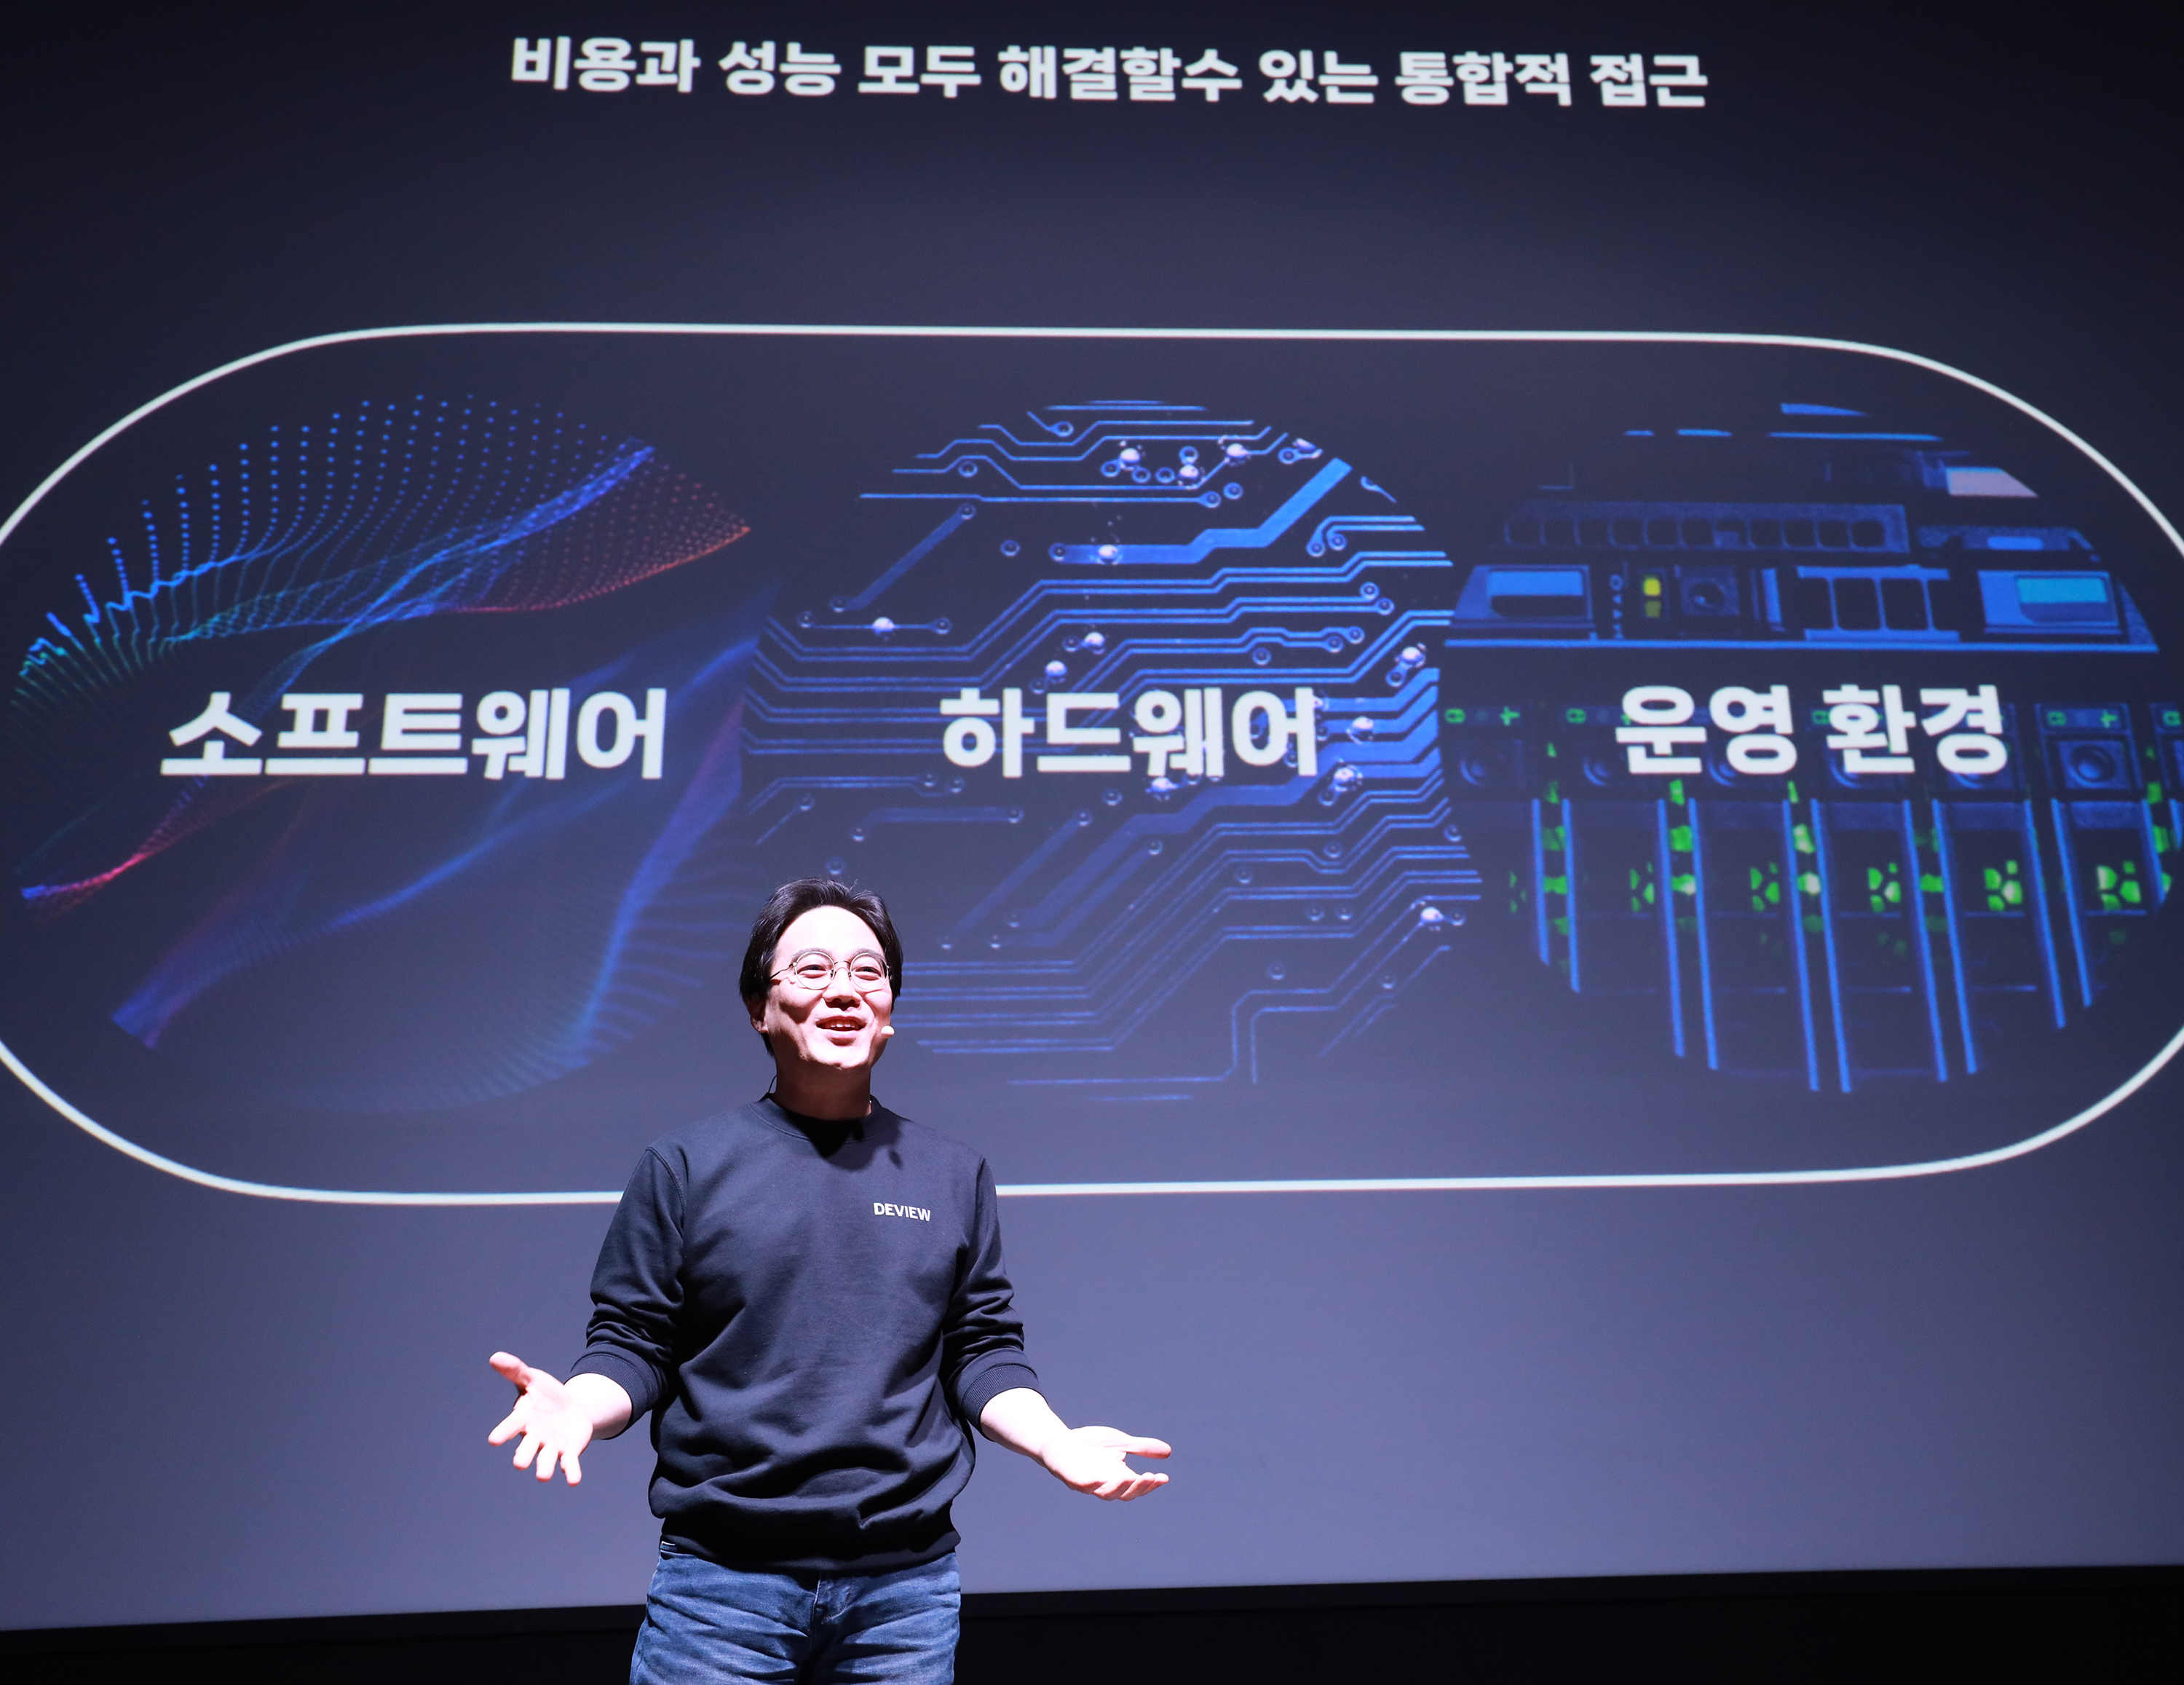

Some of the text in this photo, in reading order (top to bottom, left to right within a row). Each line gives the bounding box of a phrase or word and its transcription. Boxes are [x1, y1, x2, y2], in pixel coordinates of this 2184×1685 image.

[512, 36, 701, 93] 비용과
[719, 41, 842, 96] 성능
[858, 46, 981, 98] 모두
[1259, 50, 1379, 104] 있는
[1395, 51, 1572, 106] 통합적
[1590, 54, 1709, 107] 접근
[160, 688, 667, 780] 소프트웨어
[939, 686, 1318, 778] 하드웨어
[1615, 684, 2007, 775] 운영 환경
[873, 1202, 931, 1222] DEVIEW
